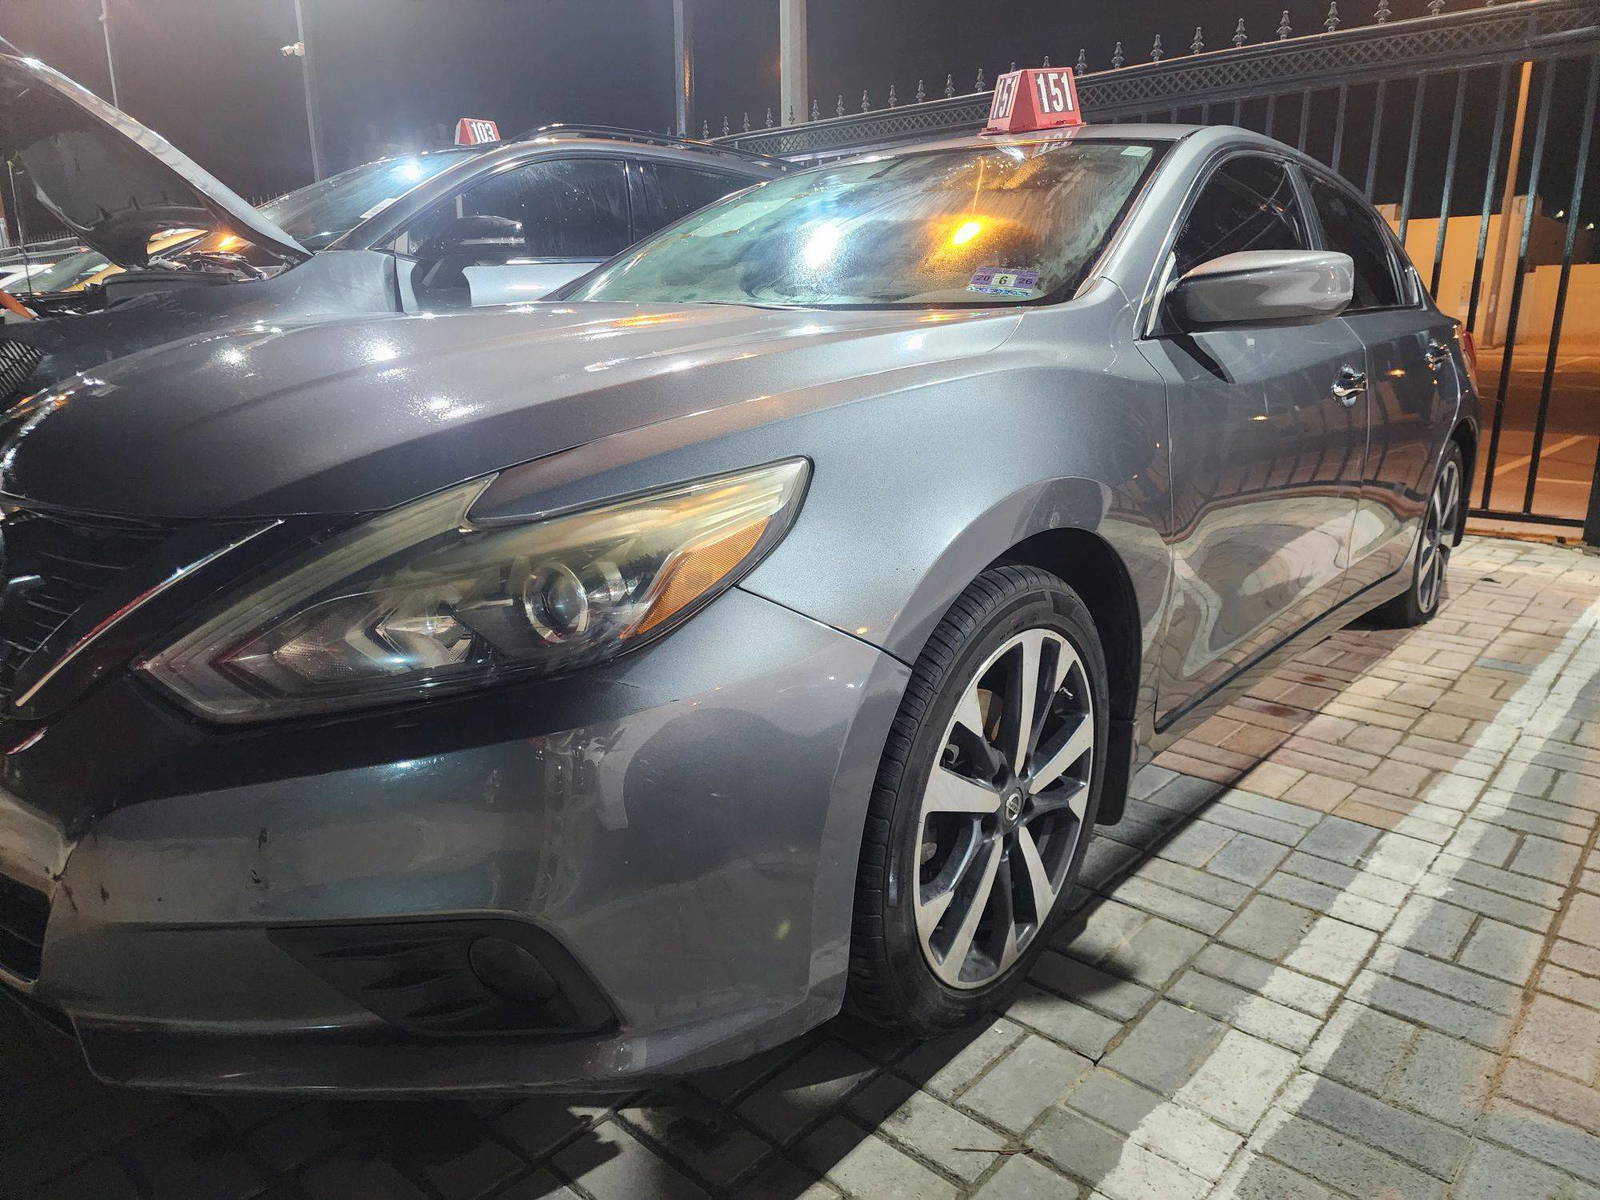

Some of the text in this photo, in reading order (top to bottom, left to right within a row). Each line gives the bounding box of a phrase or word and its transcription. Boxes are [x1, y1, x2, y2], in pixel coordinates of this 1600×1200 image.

[993, 75, 1018, 119] 151
[1037, 71, 1074, 113] 151
[471, 121, 497, 144] 103
[998, 275, 1008, 285] 6
